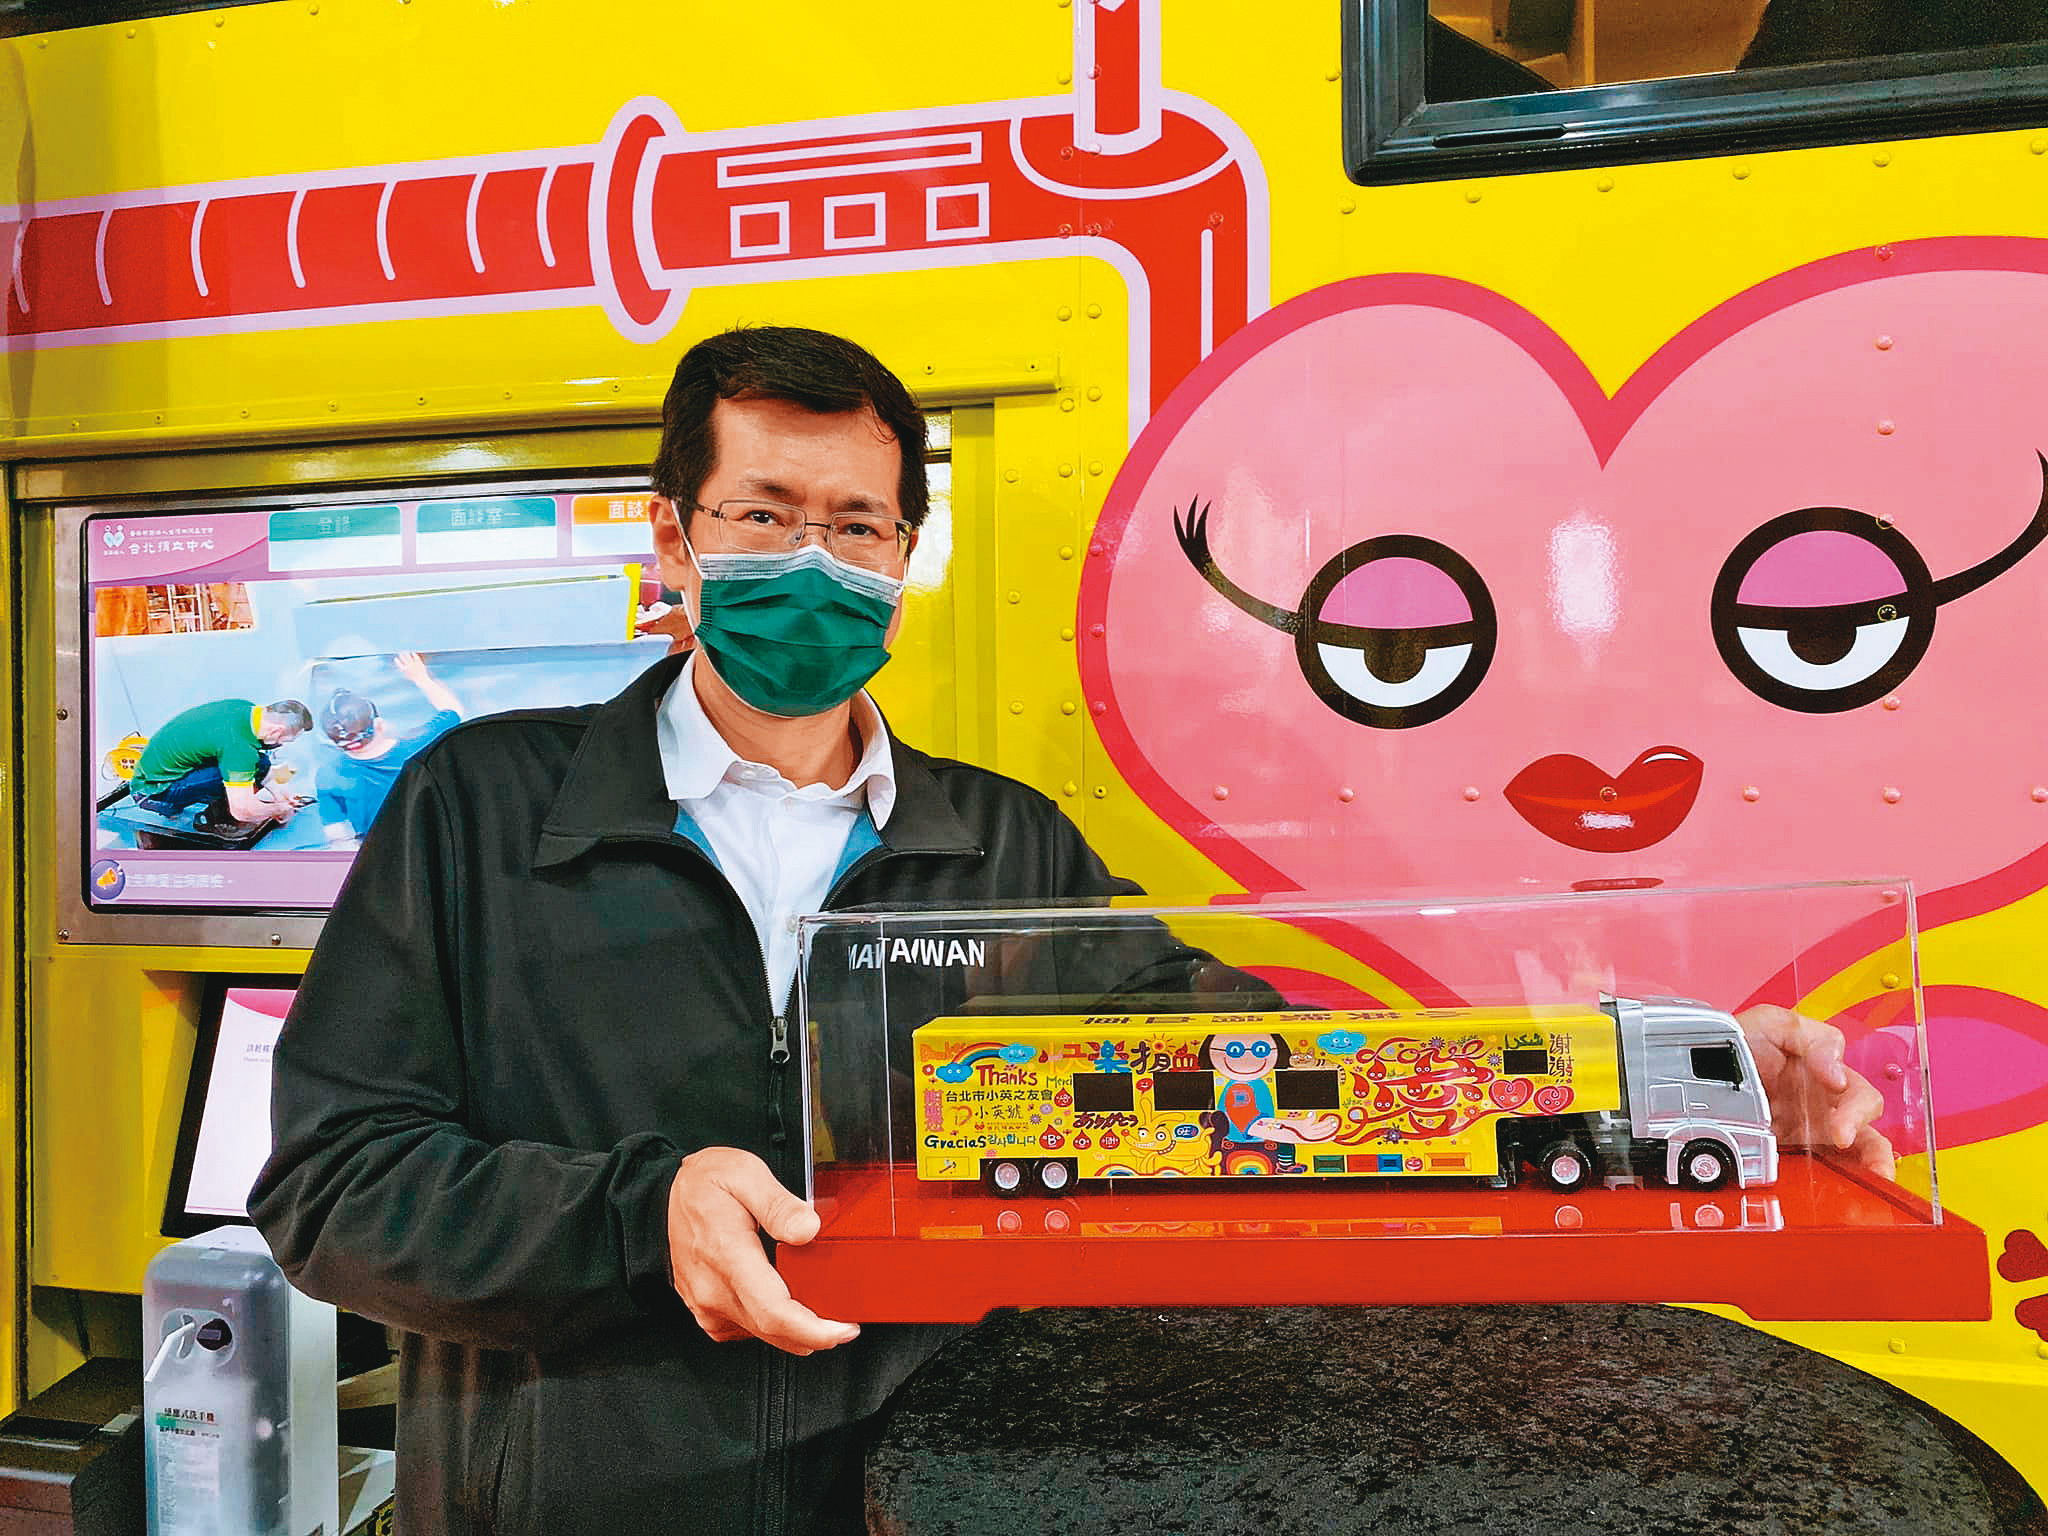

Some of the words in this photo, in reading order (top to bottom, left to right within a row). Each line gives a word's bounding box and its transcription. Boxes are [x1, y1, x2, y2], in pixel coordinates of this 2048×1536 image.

[608, 500, 650, 519] 面談
[876, 937, 985, 969] TAIWAN
[975, 1064, 1038, 1087] Thanks
[1046, 1074, 1074, 1088] Merci
[945, 1089, 1053, 1103] 台北市小英之友會
